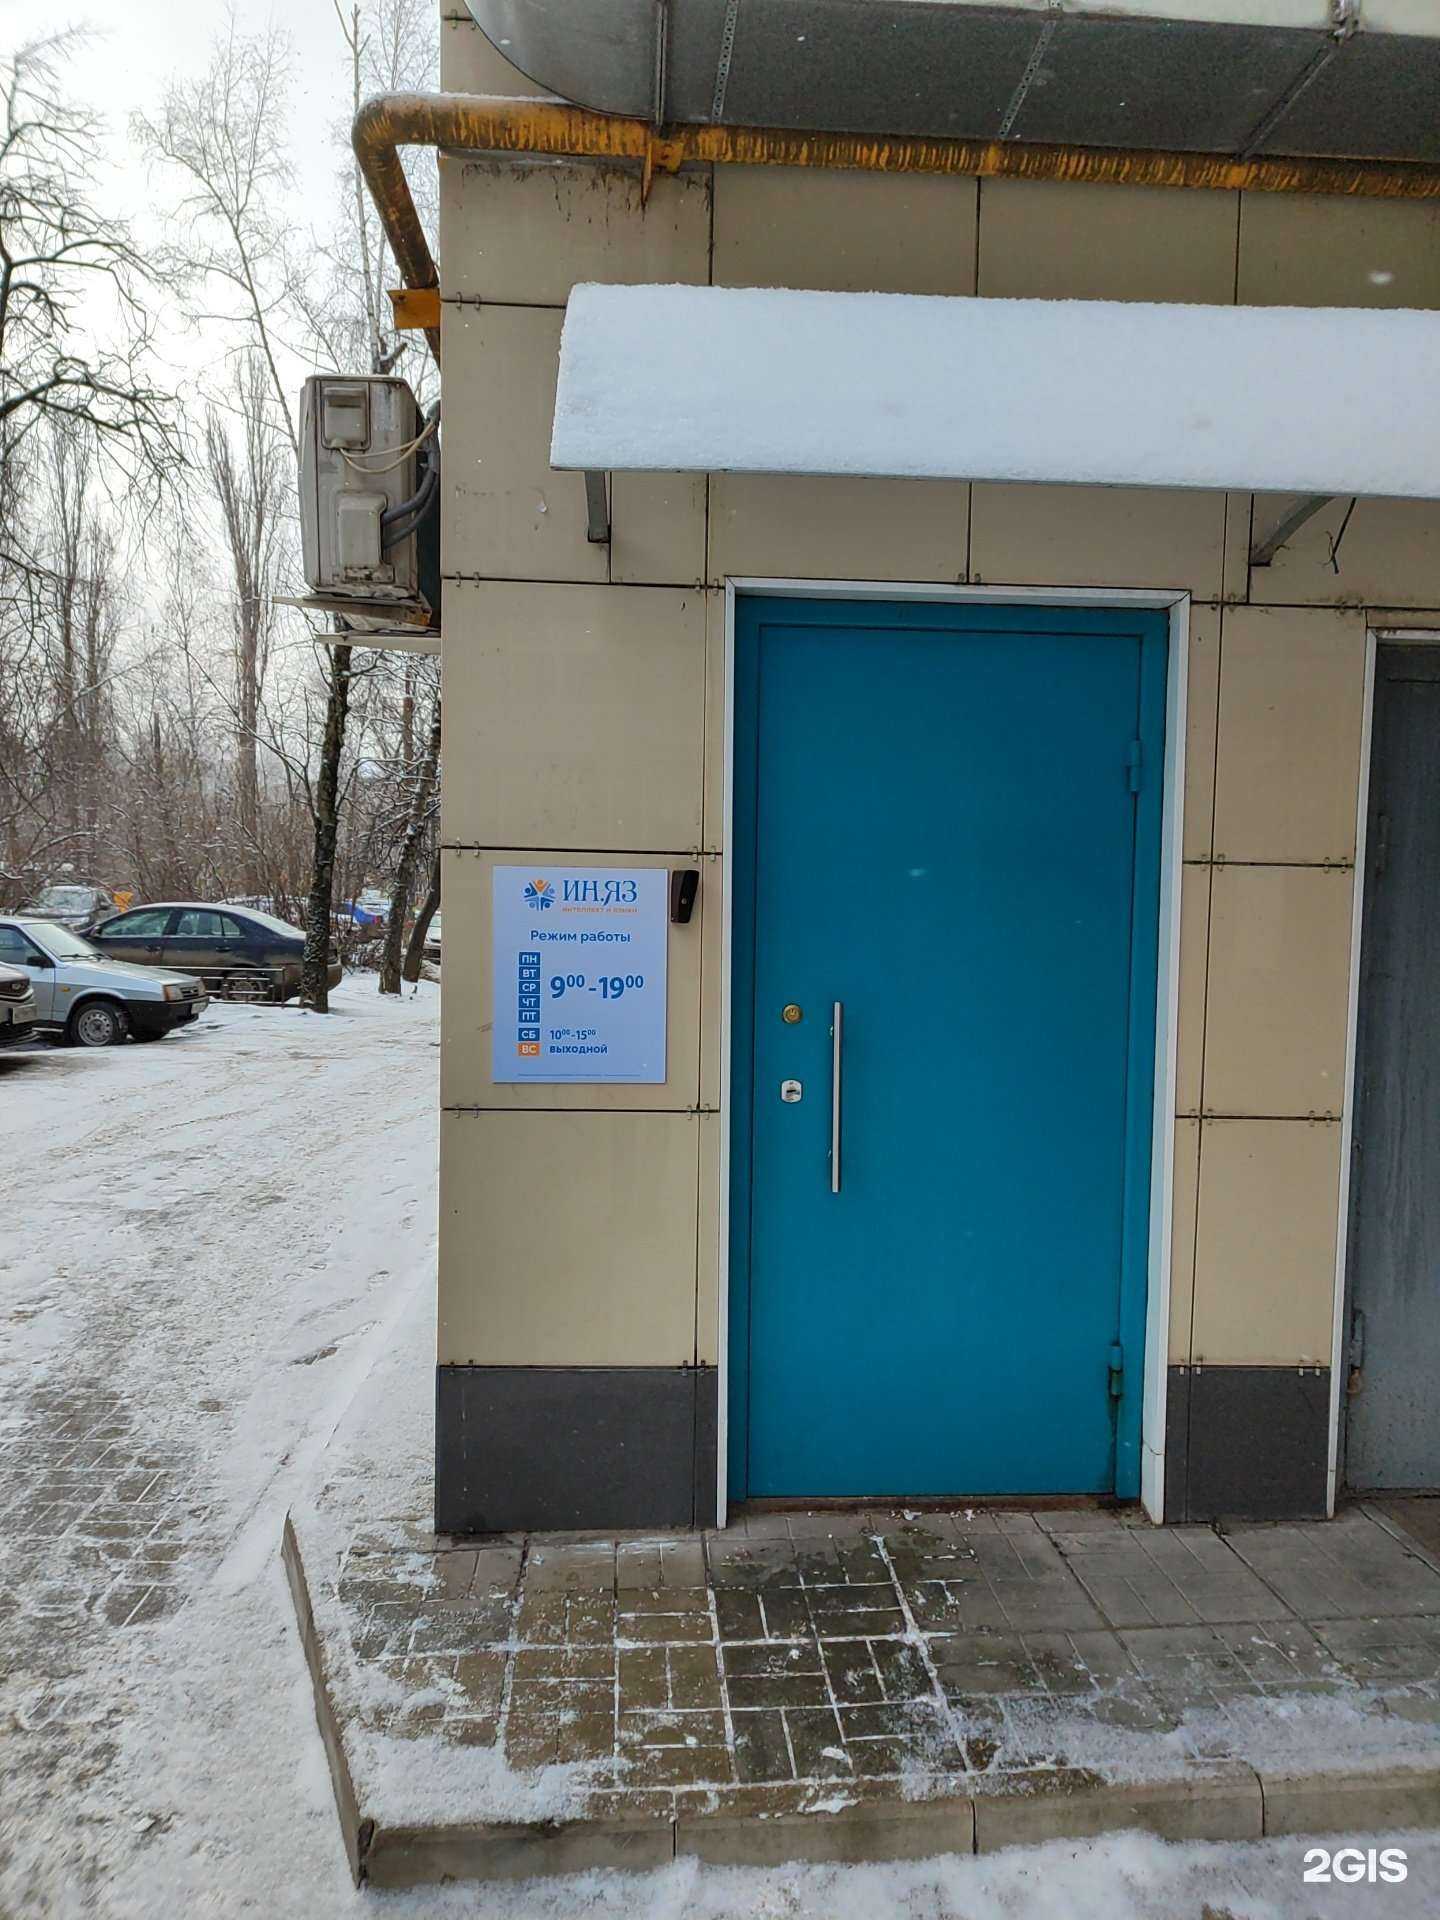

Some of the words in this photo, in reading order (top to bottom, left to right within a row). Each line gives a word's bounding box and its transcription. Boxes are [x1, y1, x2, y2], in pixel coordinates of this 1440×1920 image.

[562, 879, 638, 906] ИН.ЯЗ
[530, 930, 577, 942] Режим
[580, 931, 631, 944] работы
[521, 955, 537, 964] ПН
[522, 969, 537, 978] ВТ
[521, 983, 537, 992] СР
[522, 998, 537, 1007] ЧТ
[522, 1012, 537, 1021] ПТ
[521, 1030, 537, 1039] СБ
[521, 1045, 537, 1054] ВС
